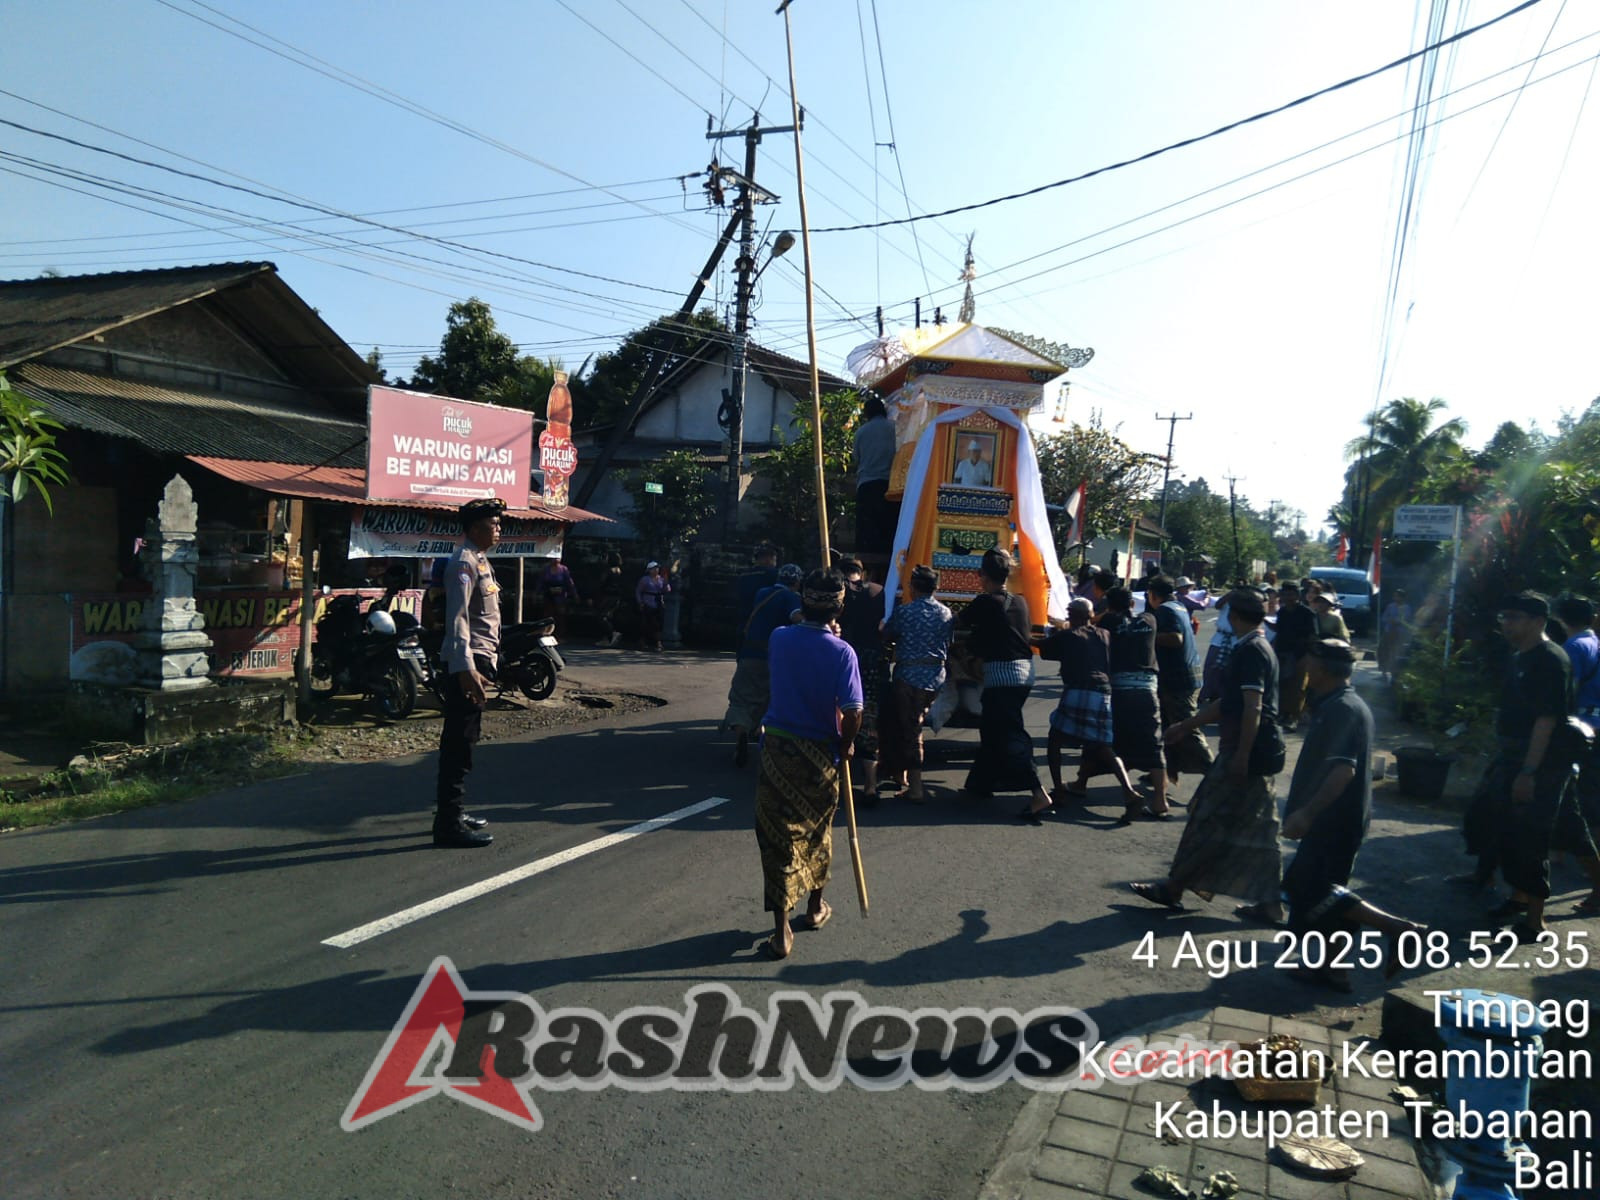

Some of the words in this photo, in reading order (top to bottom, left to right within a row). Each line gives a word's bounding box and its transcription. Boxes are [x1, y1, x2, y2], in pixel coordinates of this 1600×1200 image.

[393, 434, 472, 461] WARUNG
[476, 446, 513, 465] NASI
[386, 457, 411, 476] BE
[415, 460, 470, 482] MANIS
[473, 467, 516, 486] AYAM
[362, 509, 428, 534] WARUNG
[202, 597, 256, 629] NASI
[263, 597, 292, 626] BE
[246, 648, 279, 670] JERUK
